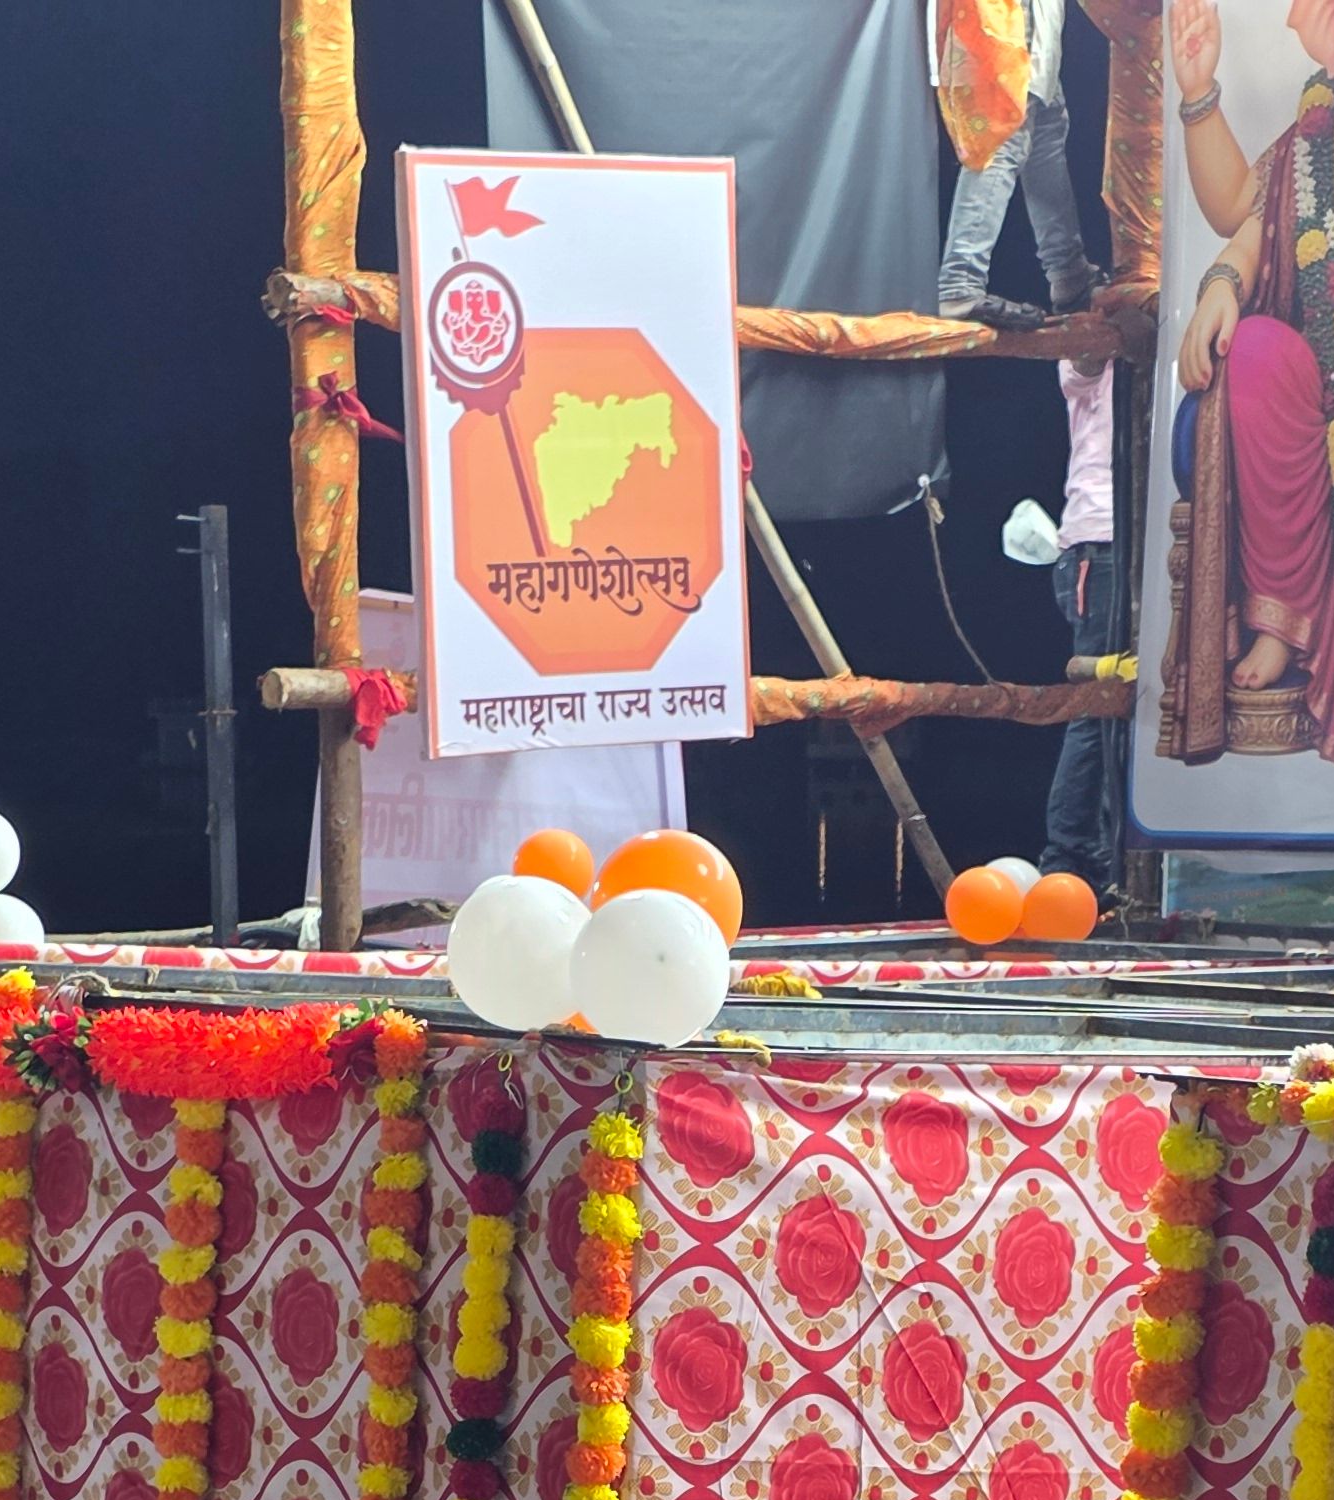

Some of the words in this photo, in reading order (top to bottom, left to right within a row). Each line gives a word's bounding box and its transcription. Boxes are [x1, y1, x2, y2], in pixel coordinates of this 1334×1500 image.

[486, 545, 702, 616] महागणेशोत्सव
[460, 692, 586, 736] महाराष्ट्राचा
[595, 689, 651, 722] राज्य
[659, 684, 727, 718] उत्सव
